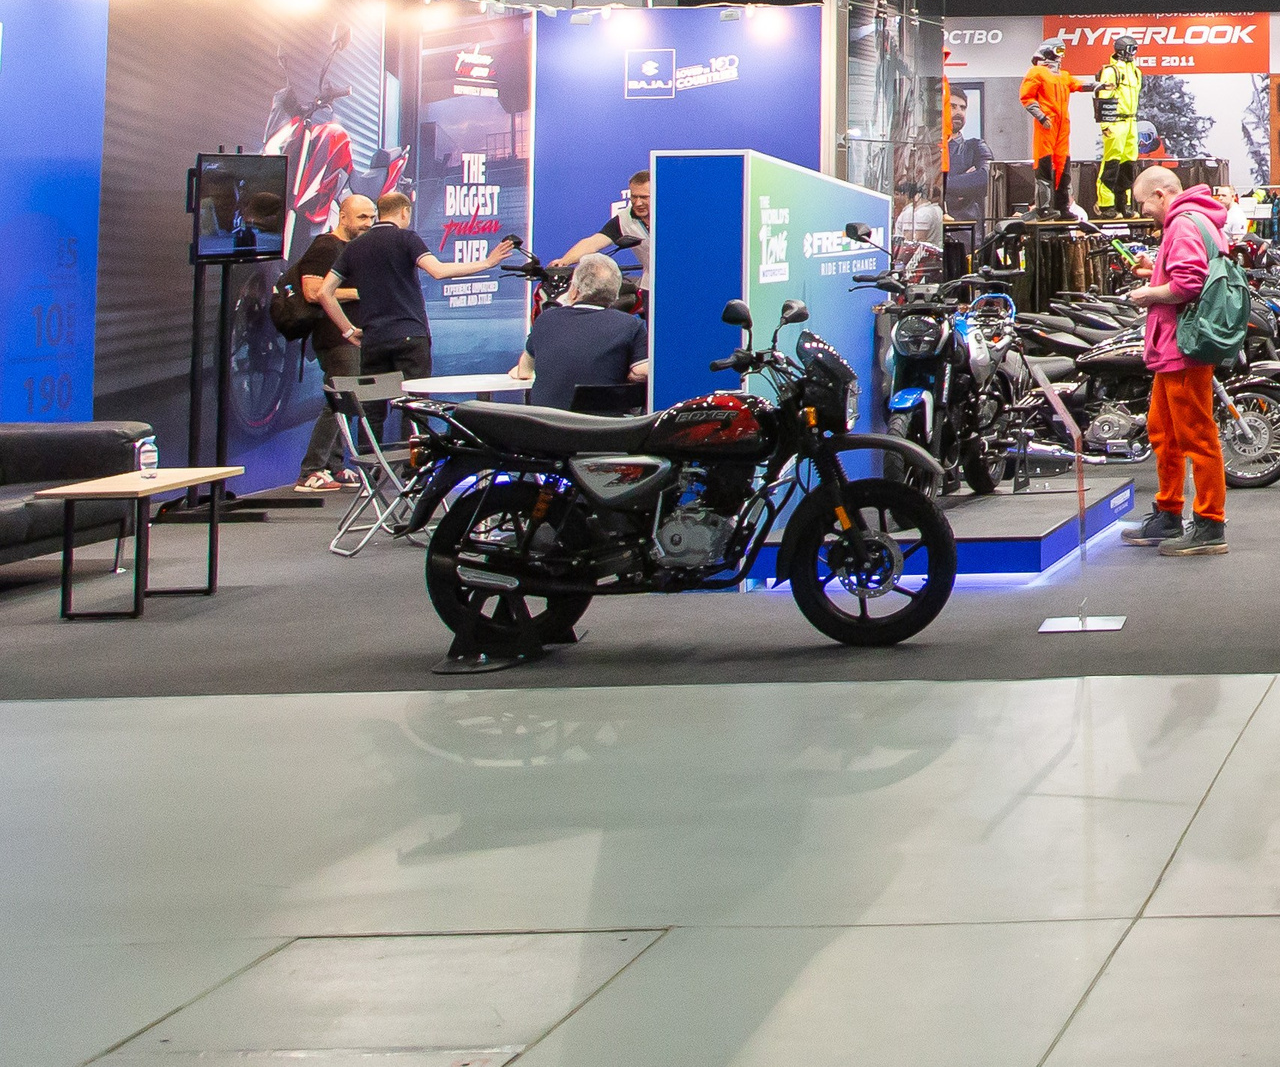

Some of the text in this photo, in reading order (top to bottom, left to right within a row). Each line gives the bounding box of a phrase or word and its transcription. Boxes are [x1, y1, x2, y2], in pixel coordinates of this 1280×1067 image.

[1057, 25, 1257, 45] HYPERLOOK
[1161, 56, 1195, 67] 2011
[628, 80, 673, 90] BAJAJ
[462, 153, 486, 183] THE
[445, 185, 500, 216] BIGGEST
[439, 204, 502, 252] pulsar
[454, 240, 489, 264] EVER
[821, 258, 877, 276] RIDE THE CHANGE
[23, 372, 73, 415] 190
[675, 411, 739, 423] BOXER
